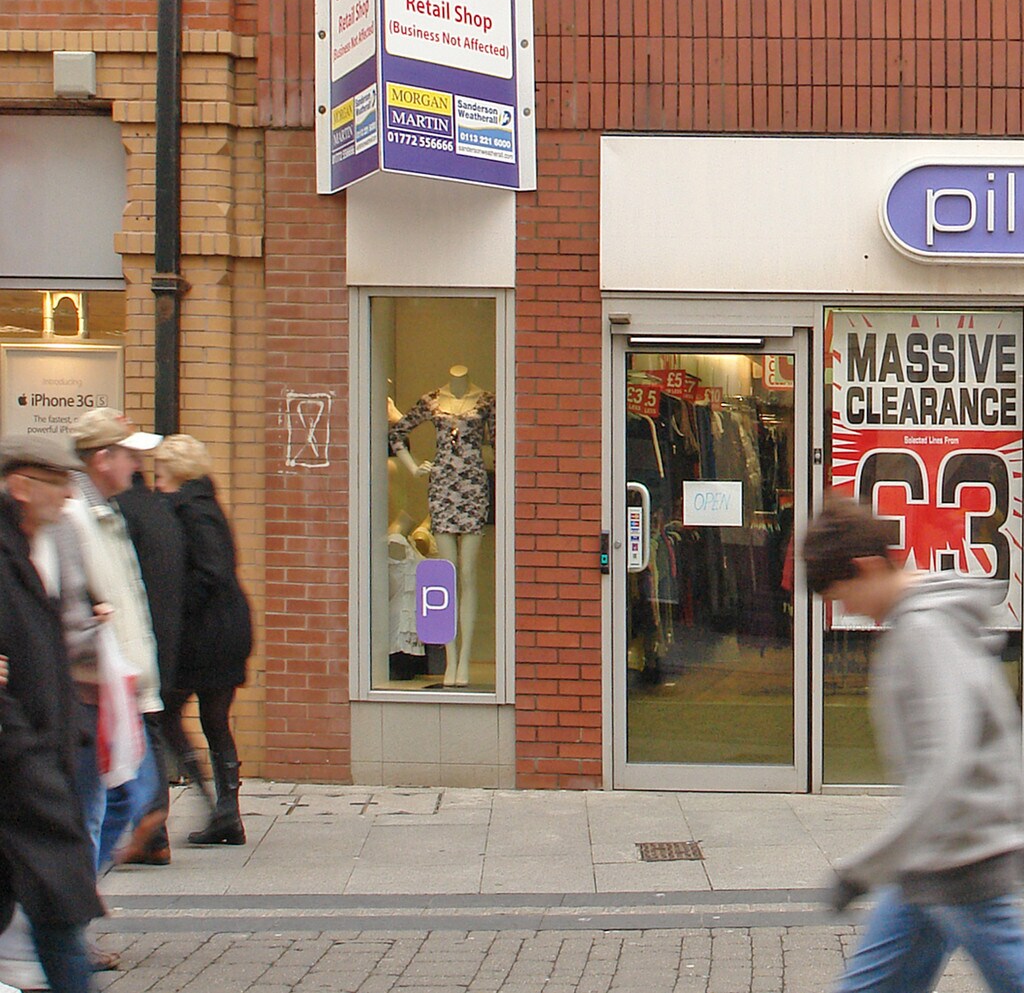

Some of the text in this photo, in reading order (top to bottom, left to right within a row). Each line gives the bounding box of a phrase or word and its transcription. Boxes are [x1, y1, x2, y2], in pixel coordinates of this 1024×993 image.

[355, 0, 370, 21] Shop
[454, 5, 493, 33] Shop
[389, 19, 509, 59] (Business Not Affected)
[392, 88, 448, 110] MORGAN
[457, 99, 498, 115] Sanderson
[392, 110, 449, 132] MARTIN
[457, 108, 498, 124] Weatherall
[387, 131, 418, 146] 01772
[419, 135, 454, 152] 556666
[460, 132, 478, 143] 0113
[847, 332, 1017, 384] MASSIVE
[667, 372, 682, 388] £5
[31, 394, 75, 408] iPhone
[76, 394, 94, 407] 3G
[846, 386, 1017, 426] CLEARANCE
[33, 415, 47, 423] The
[27, 426, 58, 434] powerful
[903, 435, 960, 445] Selected Lines From
[693, 492, 732, 511] OPEN
[422, 586, 449, 617] p
